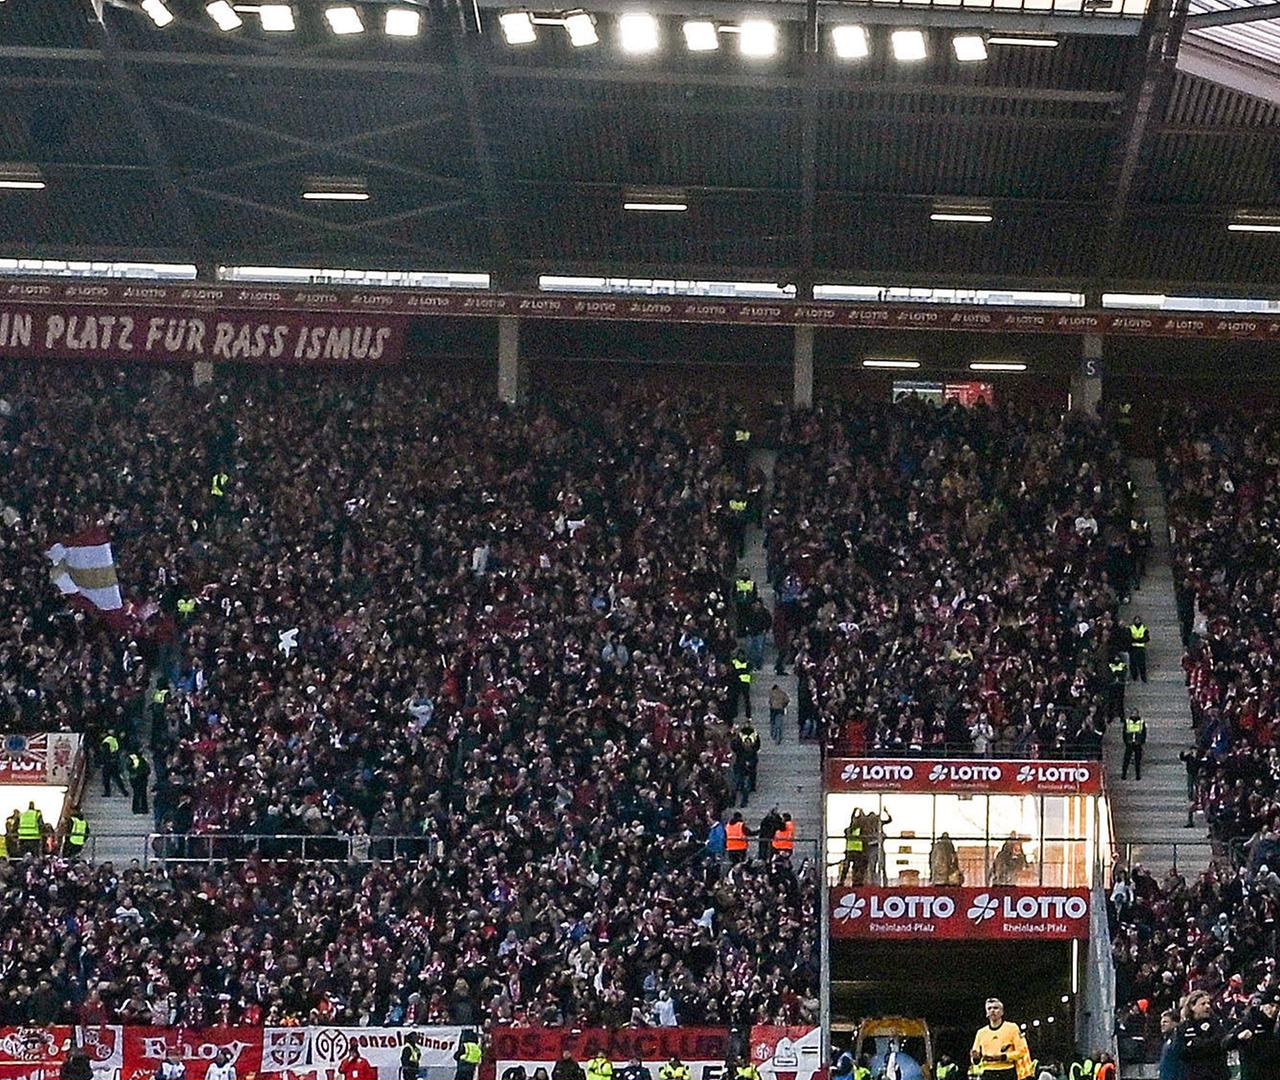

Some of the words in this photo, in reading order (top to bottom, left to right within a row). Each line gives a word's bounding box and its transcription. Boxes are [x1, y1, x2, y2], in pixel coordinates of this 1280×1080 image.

[46, 316, 134, 350] PLATZ
[294, 326, 391, 360] ISMUS
[862, 765, 914, 781] LOTTO
[950, 765, 1001, 781] LOTTO
[1038, 766, 1090, 783] LOTTO
[870, 896, 955, 919] LOTTO
[1003, 896, 1087, 919] LOTTO
[869, 923, 935, 933] Rheinland-Pfalz
[1003, 923, 1068, 933] Rheinland-Pfalz
